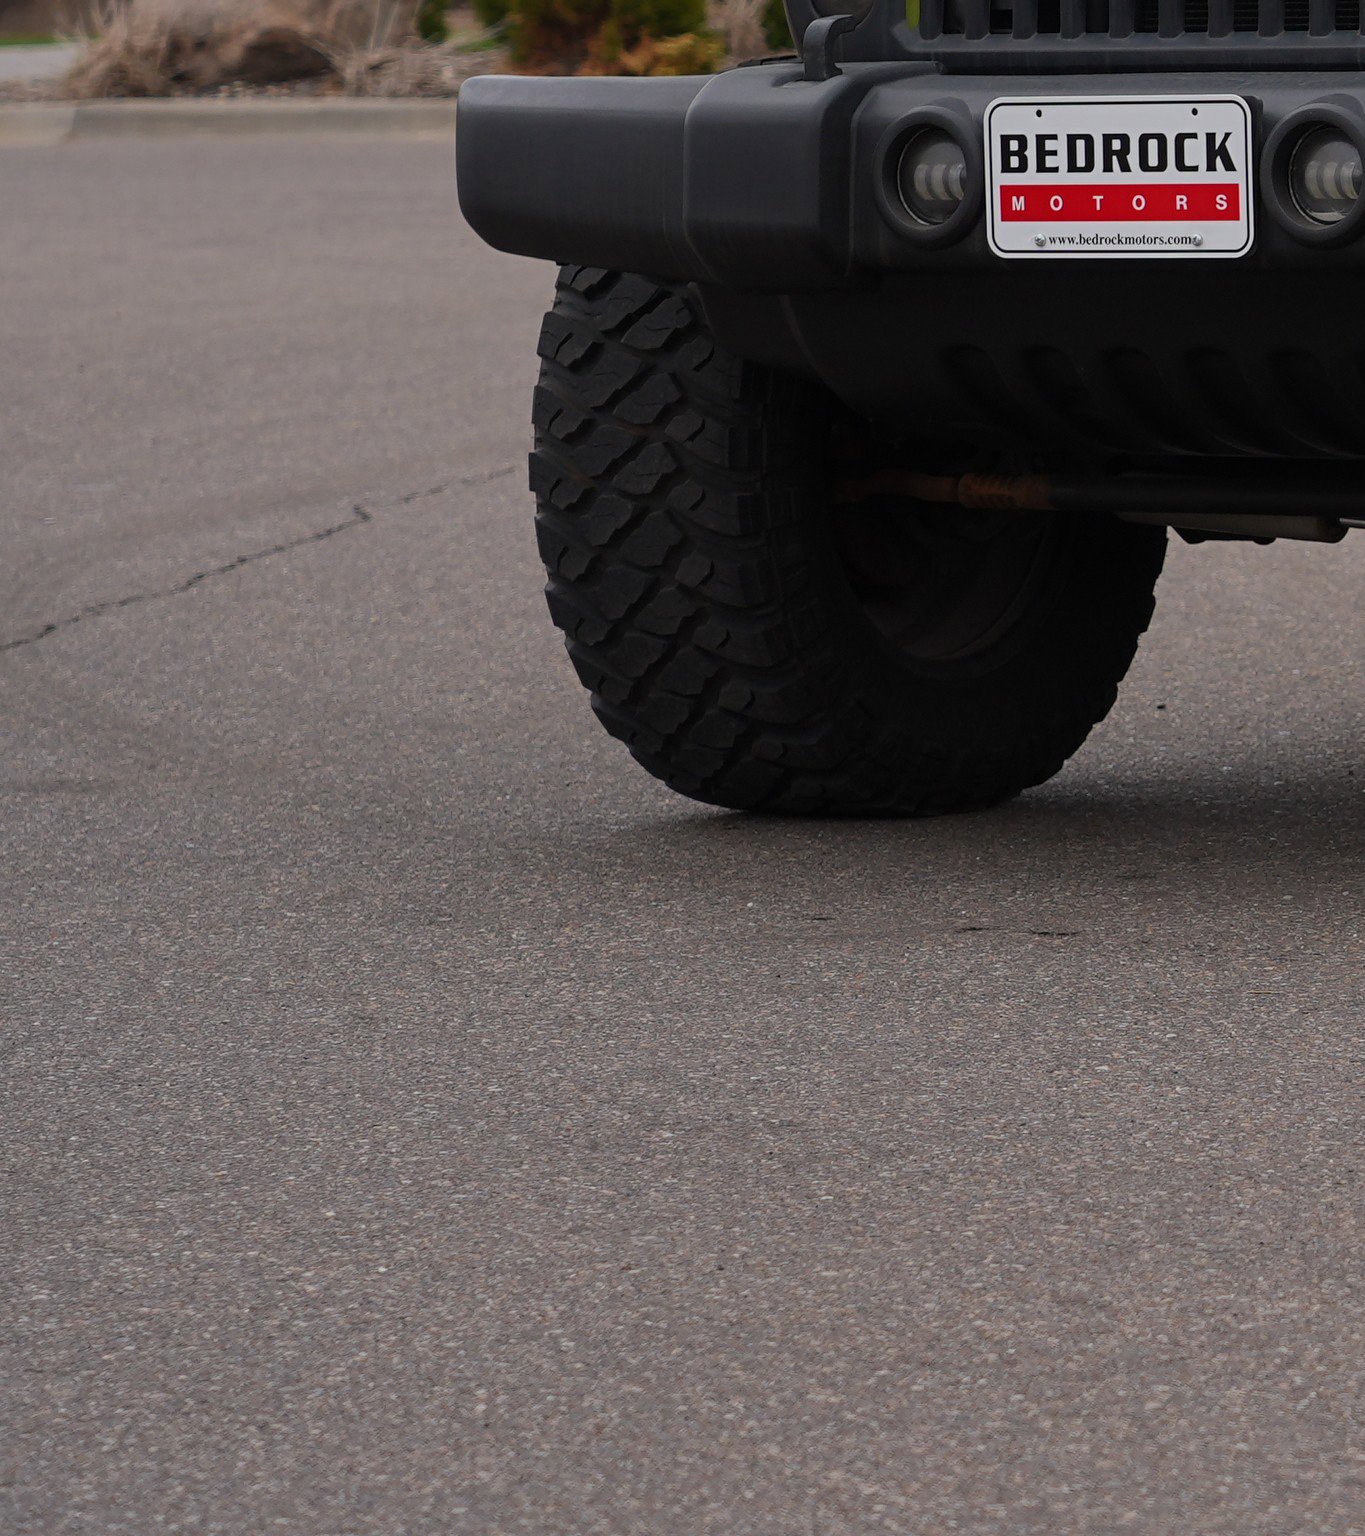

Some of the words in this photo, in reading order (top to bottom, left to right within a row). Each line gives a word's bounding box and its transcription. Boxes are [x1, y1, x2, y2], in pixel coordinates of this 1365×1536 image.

[1000, 132, 1237, 173] BEDROCK
[1011, 194, 1228, 211] MOTORS
[1048, 233, 1192, 246] www.bedrockmotors.com
